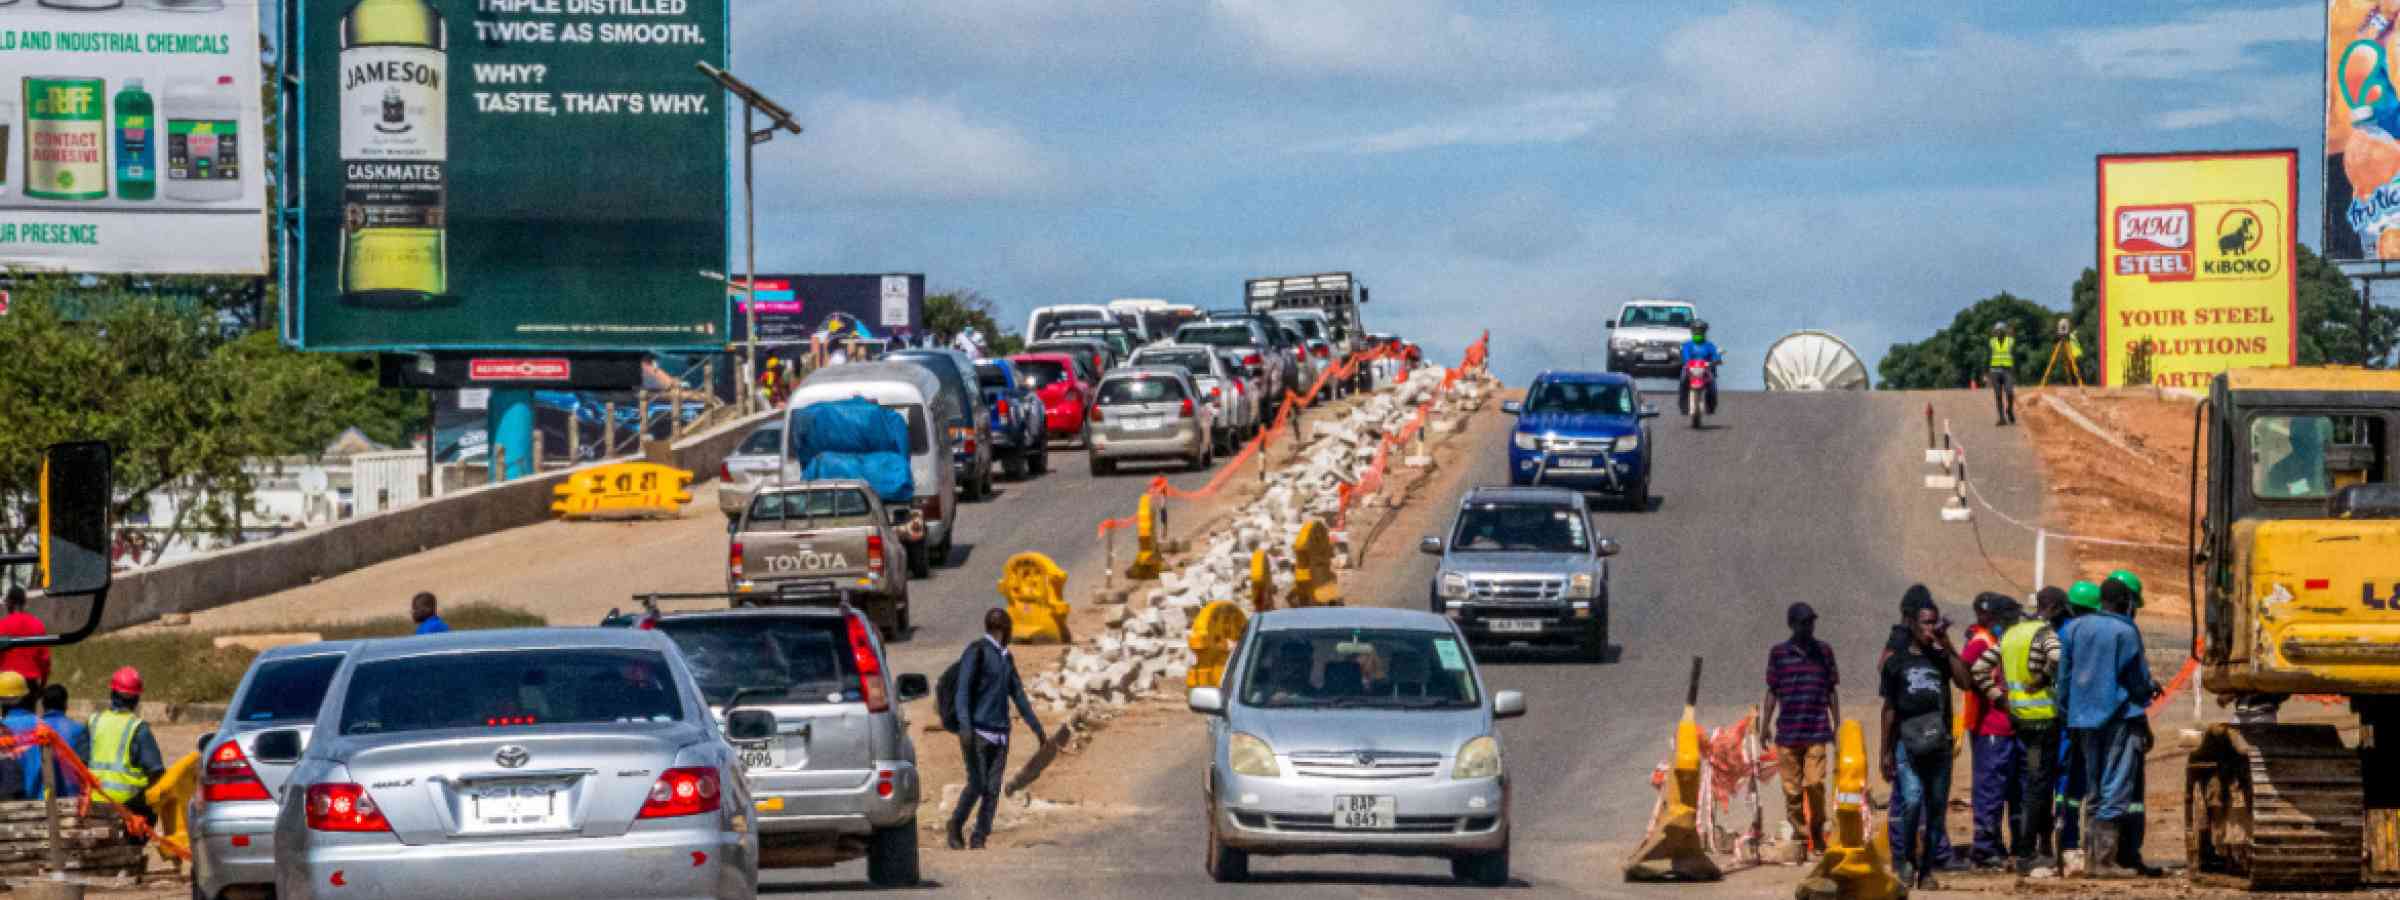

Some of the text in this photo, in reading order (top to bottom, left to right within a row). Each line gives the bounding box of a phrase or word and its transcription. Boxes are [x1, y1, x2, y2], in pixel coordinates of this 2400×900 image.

[478, 0, 686, 15] TRIPLE DISTILLED
[20, 31, 51, 49] AND
[56, 32, 141, 52] INDUSTRIAL
[146, 33, 229, 53] CHEMICALS
[473, 21, 705, 44] TWICE AS SMOOTH.
[346, 61, 439, 91] JAMESON
[473, 64, 546, 83] WHY?
[473, 93, 708, 116] TASTE, THAT'S WHY.
[33, 133, 97, 147] CONTACT
[32, 149, 98, 162] ADHESIVE
[348, 164, 440, 180] CASKMATES
[22, 224, 97, 245] PRESENCE
[2127, 215, 2185, 236] MMI
[2120, 255, 2187, 273] STEEL
[2120, 307, 2275, 328] YOUR STEEL
[2126, 337, 2268, 356] SOLUTIONS
[764, 552, 849, 572] TOYOTA
